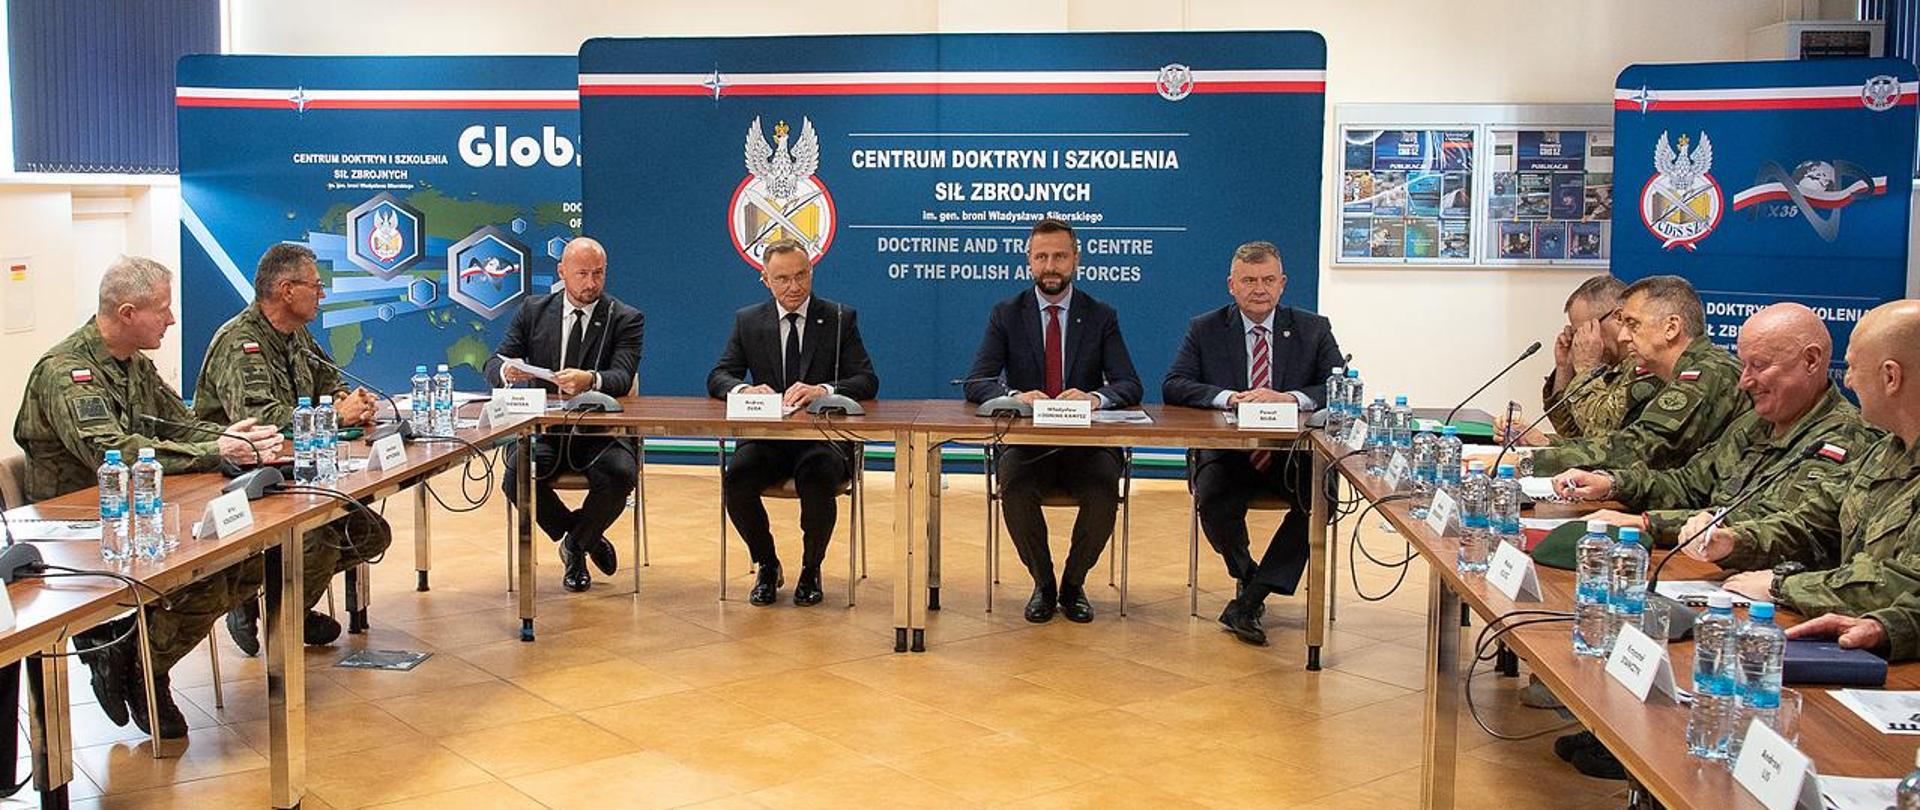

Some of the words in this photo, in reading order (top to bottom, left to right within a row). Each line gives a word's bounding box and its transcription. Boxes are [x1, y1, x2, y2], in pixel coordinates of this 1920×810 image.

[458, 125, 581, 168] Glob
[293, 153, 340, 164] CENTRUM
[342, 154, 386, 164] DOKTRYN
[388, 154, 393, 164] I
[395, 154, 448, 165] SZKOLENIA
[852, 150, 946, 168] CENTRUM
[952, 150, 1046, 169] DOKTRYN
[1053, 151, 1059, 168] I
[1065, 150, 1179, 169] SZKOLENIA
[333, 169, 349, 179] SIŁ
[351, 169, 408, 180] ZBROJNYCH
[935, 182, 965, 201] SIŁ
[970, 182, 1090, 201] ZBROJNYCH
[922, 210, 938, 220] im.
[939, 211, 960, 223] gen.
[962, 210, 987, 221] broni
[988, 210, 1045, 223] Władysława
[1046, 210, 1104, 223] Sikorskiego
[878, 237, 959, 253] DOCTRINE
[963, 238, 998, 253] AND
[1087, 239, 1153, 255] CENTRE
[888, 263, 909, 279] OF
[913, 264, 946, 279] THE
[950, 264, 1009, 280] POLISH
[1076, 265, 1141, 281] FORCES
